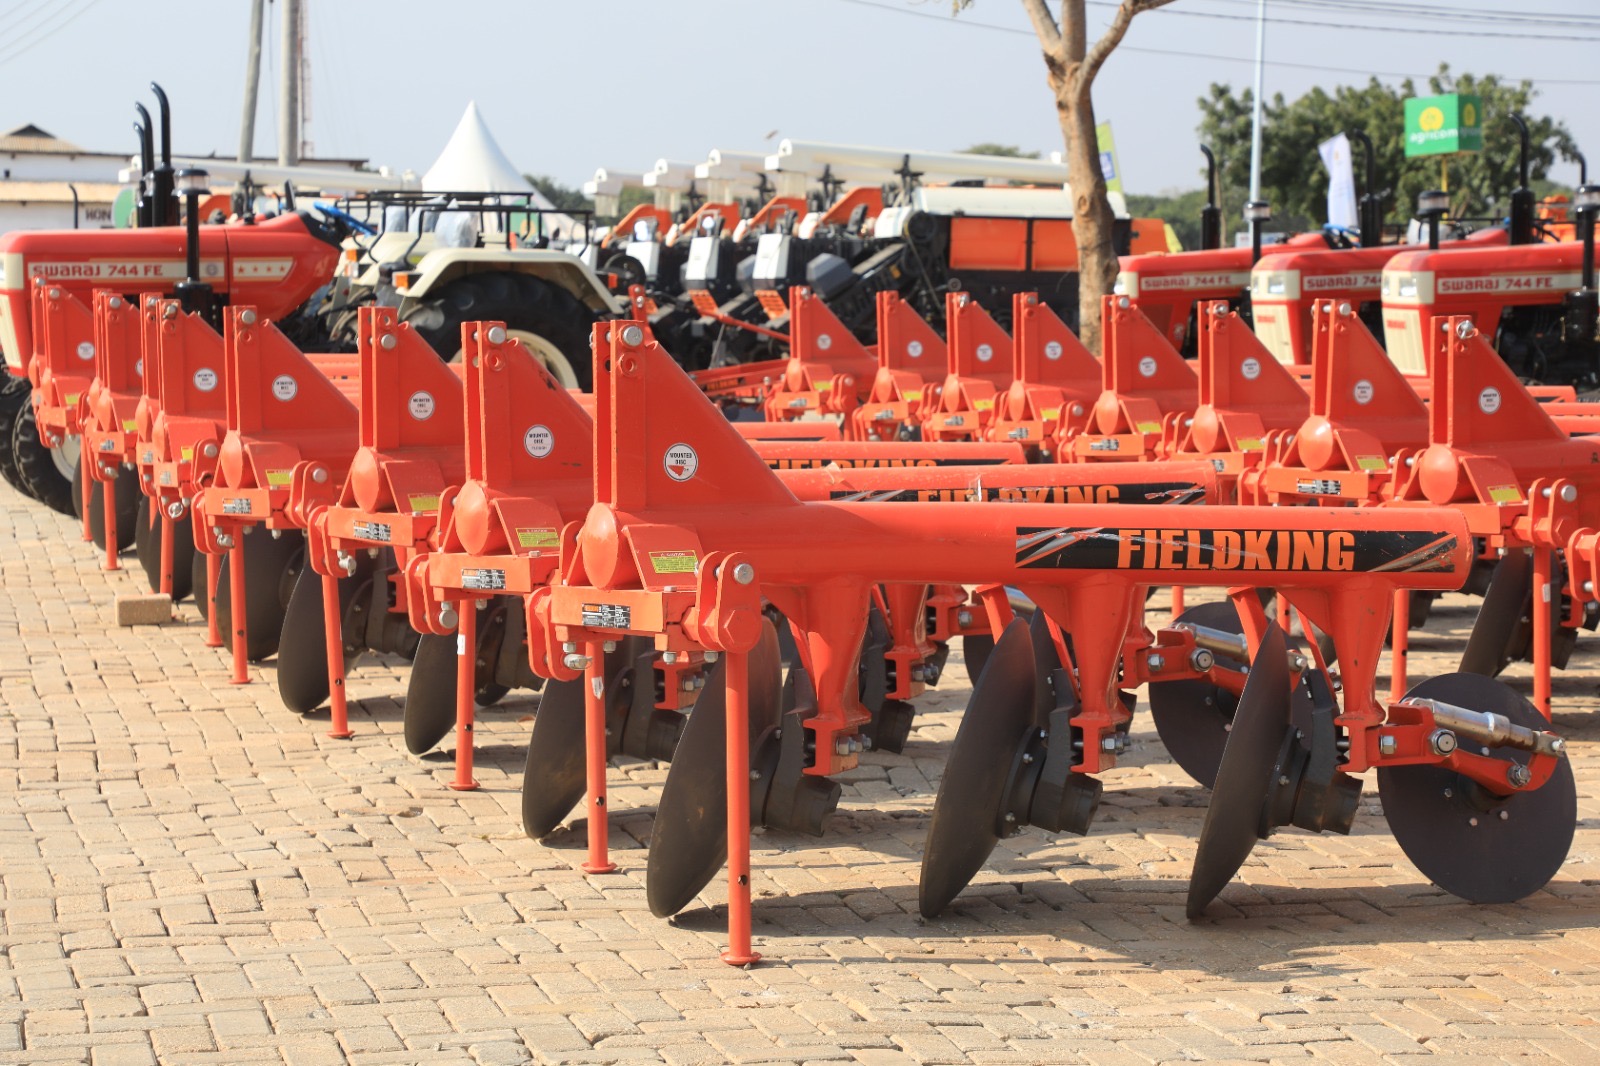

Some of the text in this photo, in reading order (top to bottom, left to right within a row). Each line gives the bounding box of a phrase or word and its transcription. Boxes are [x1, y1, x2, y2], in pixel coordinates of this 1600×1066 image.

[108, 264, 139, 276] 744
[144, 264, 163, 276] FE
[1194, 276, 1216, 287] 744
[1217, 275, 1232, 285] FE
[1504, 277, 1531, 290] 744
[1535, 276, 1553, 288] FE
[1116, 529, 1356, 572] FIELDKING
